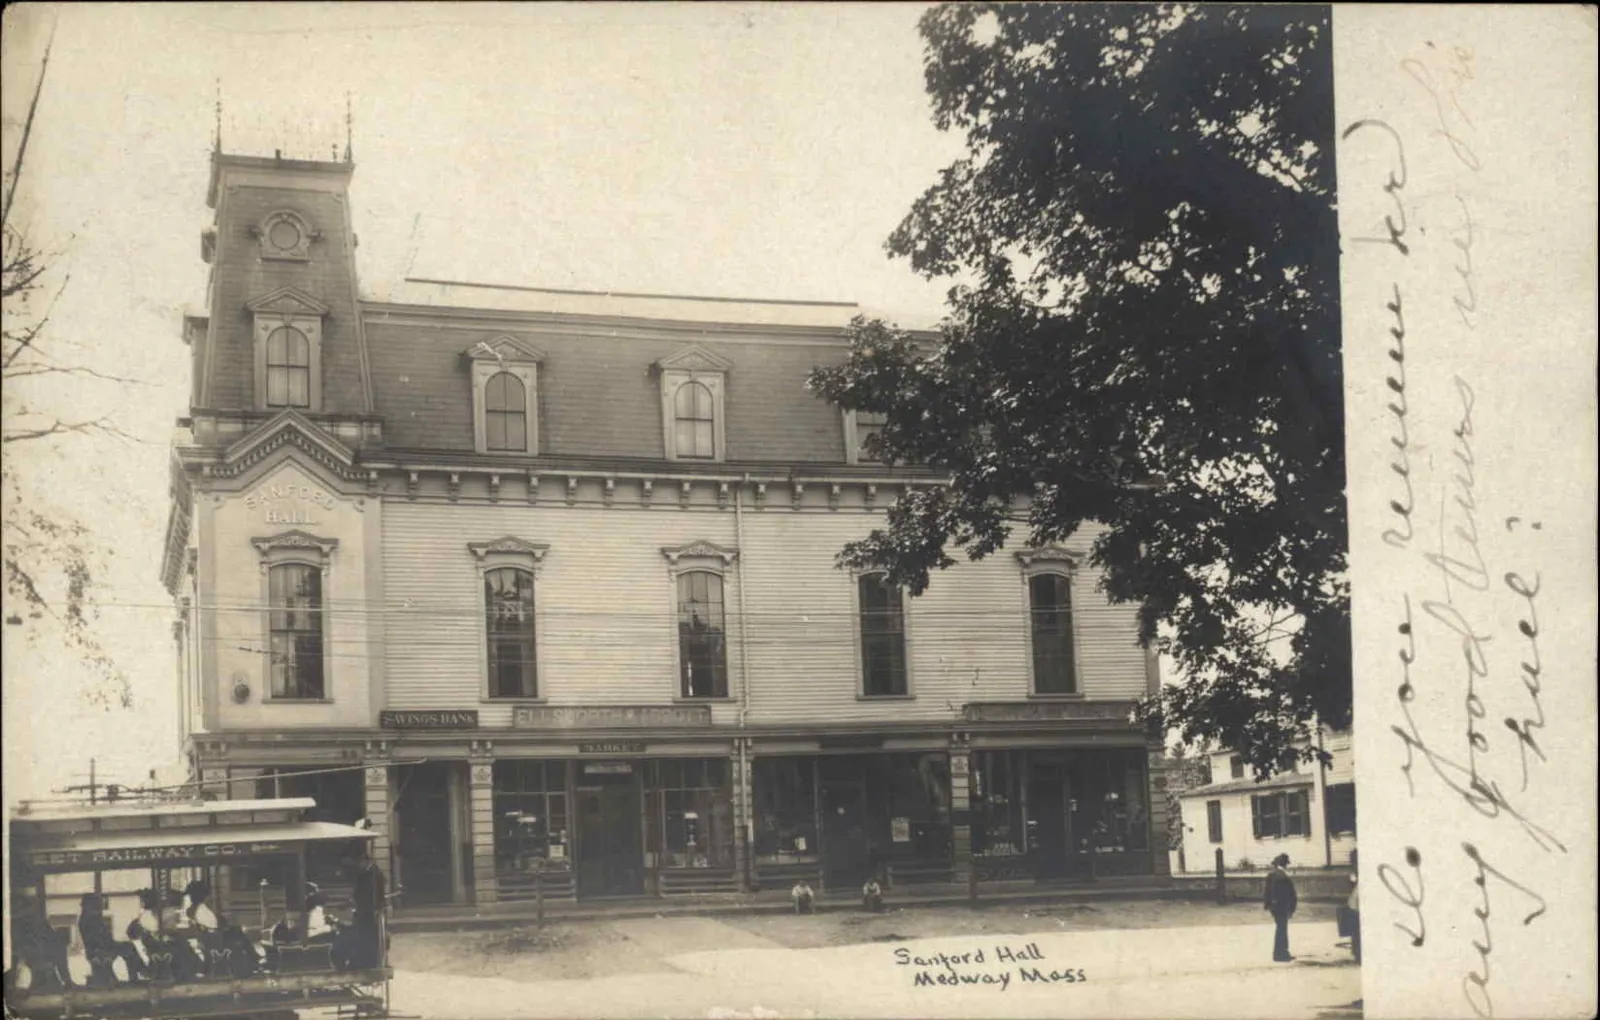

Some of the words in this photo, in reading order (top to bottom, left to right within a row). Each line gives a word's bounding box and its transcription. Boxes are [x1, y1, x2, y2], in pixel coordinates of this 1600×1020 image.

[245, 484, 336, 511] SANFORD
[265, 510, 315, 525] HALL
[1391, 593, 1463, 798] you
[383, 712, 438, 725] SAVINGS
[440, 712, 476, 724] BANK
[1421, 599, 1568, 852] good
[583, 743, 641, 753] MARKET
[92, 845, 195, 863] RAILWAY
[204, 843, 243, 857] CO.
[1376, 844, 1425, 948] Do
[1459, 840, 1547, 1018] any
